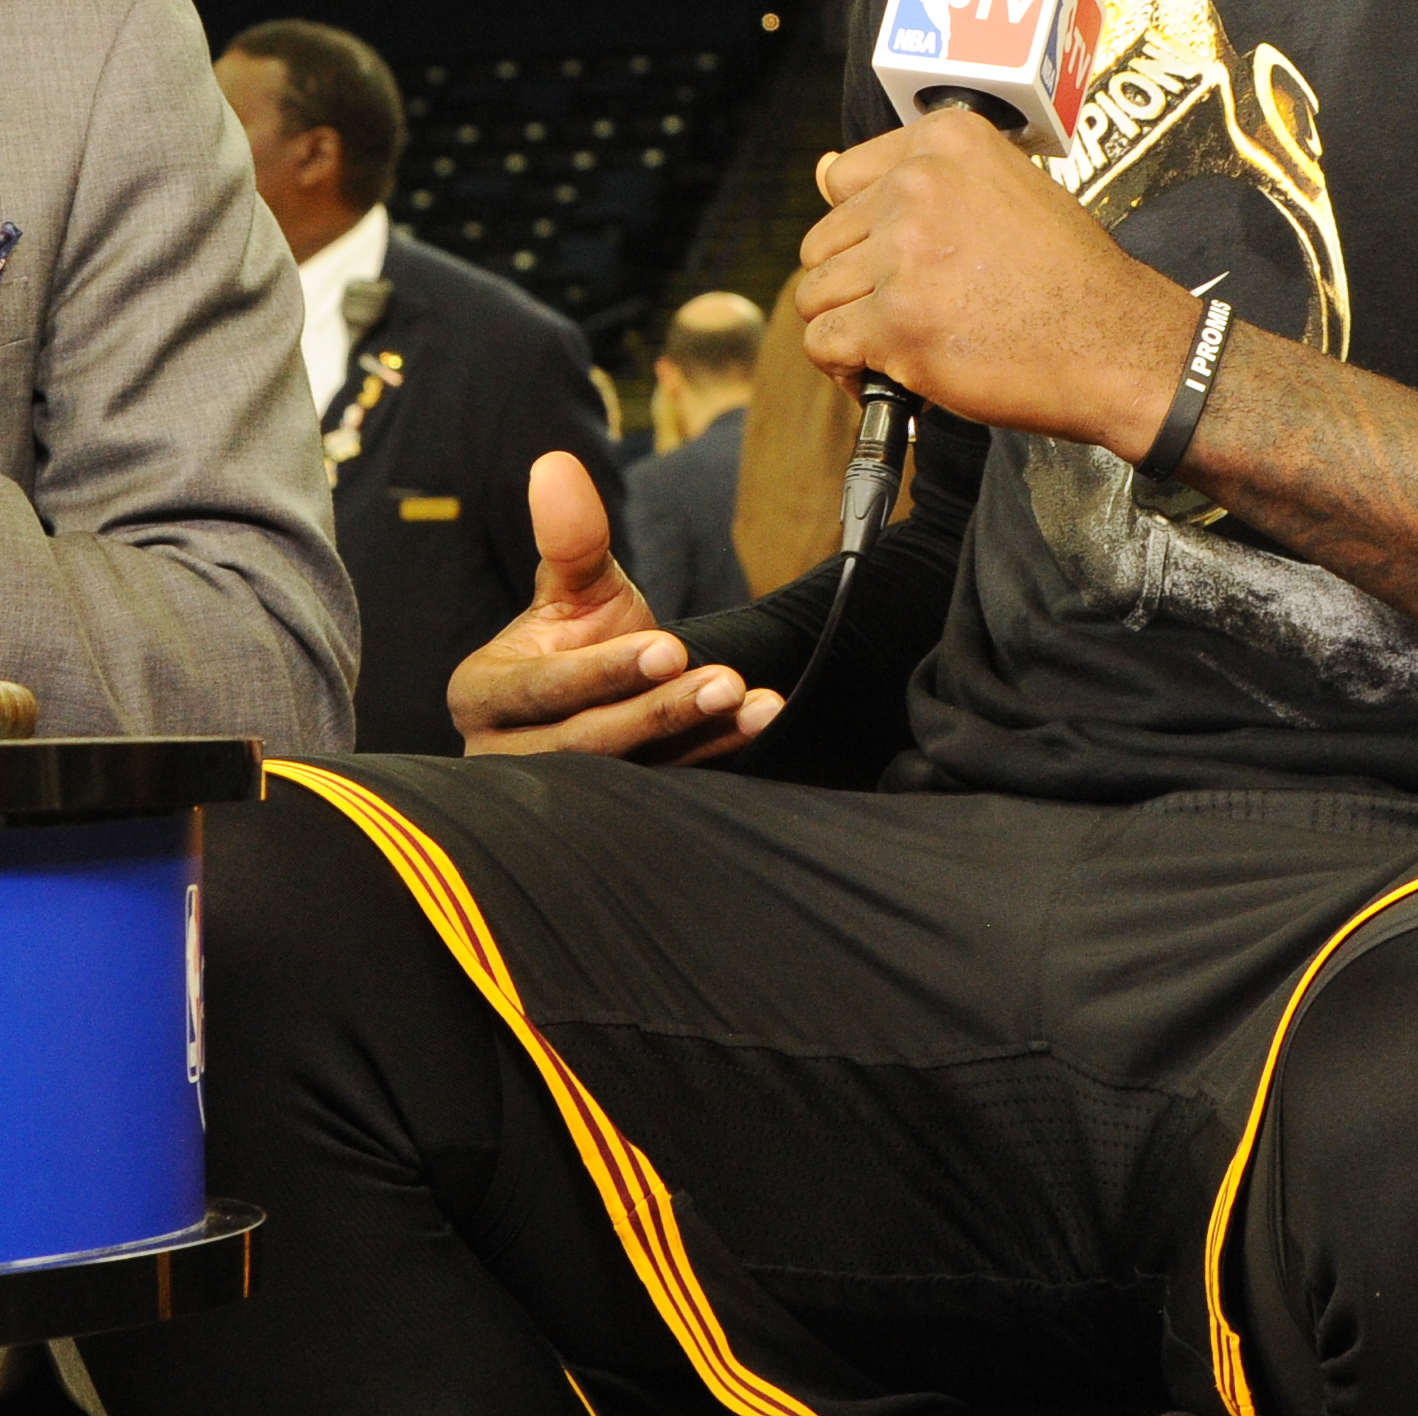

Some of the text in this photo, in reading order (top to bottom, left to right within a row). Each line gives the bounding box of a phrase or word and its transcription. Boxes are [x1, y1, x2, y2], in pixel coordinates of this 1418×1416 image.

[892, 27, 937, 55] NBA
[1067, 26, 1092, 90] TV
[1184, 298, 1233, 393] I PROMIS
